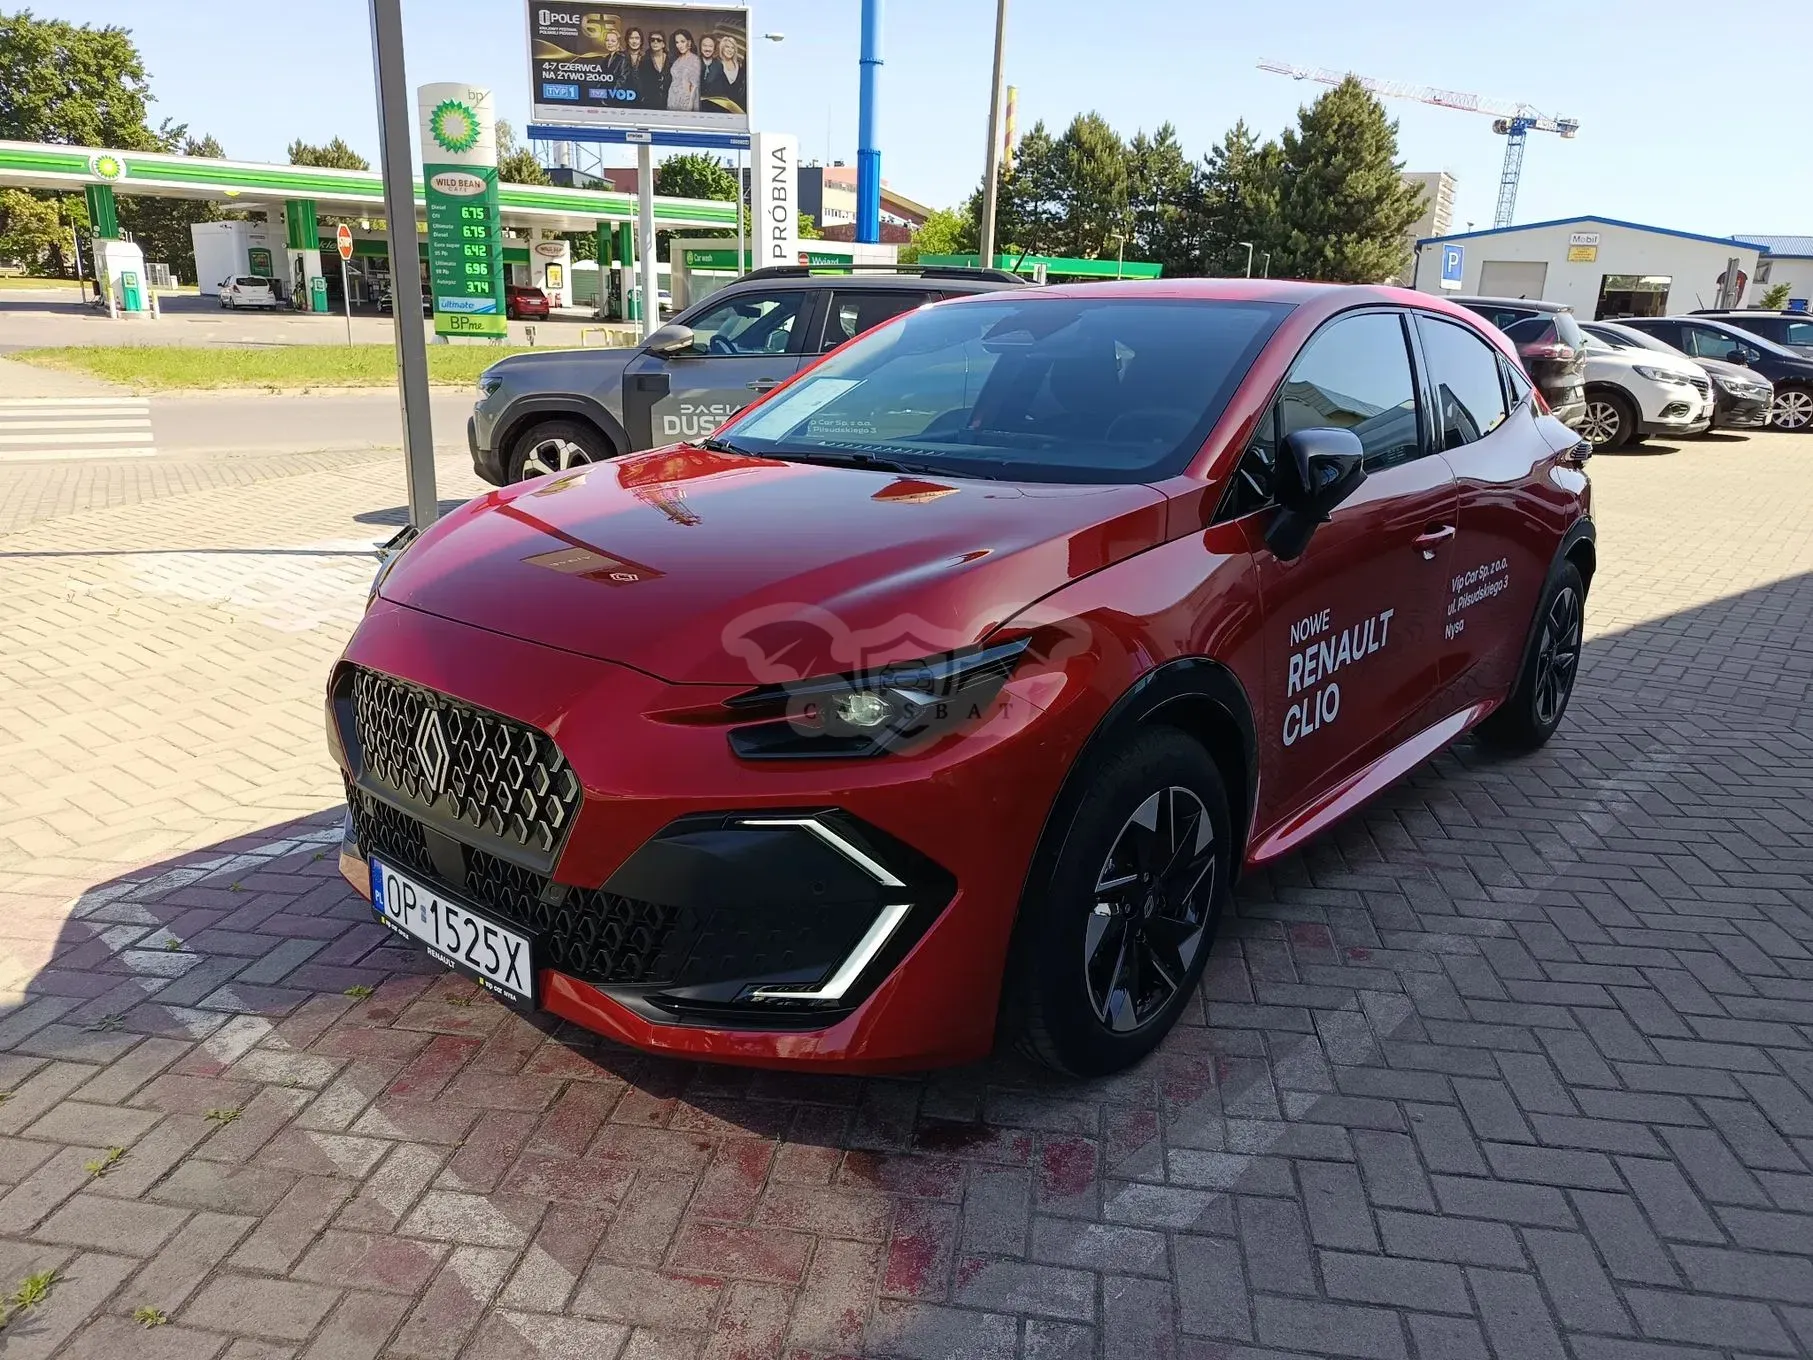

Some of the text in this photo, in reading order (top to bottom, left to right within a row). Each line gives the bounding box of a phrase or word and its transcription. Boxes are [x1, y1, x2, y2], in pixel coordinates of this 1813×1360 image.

[539, 10, 580, 25] OPOLE
[542, 62, 602, 72] 4-7 CZERWCA
[542, 71, 555, 79] NA
[557, 71, 585, 80] ŻYWO
[468, 89, 484, 103] bp
[608, 89, 636, 101] VOD
[436, 179, 481, 188] WILD BEAN
[769, 146, 787, 259] PRÓBNA
[461, 207, 484, 219] 6.75
[463, 226, 486, 238] 6.75
[1572, 235, 1598, 243] Mobil
[464, 245, 487, 257] 6.42
[465, 263, 488, 275] 6.96
[1448, 252, 1459, 273] P
[466, 281, 489, 293] 3.74
[663, 415, 730, 435] DUST
[1452, 574, 1464, 593] Vip
[1464, 571, 1479, 586] Car
[1478, 564, 1490, 581] Sp.
[1495, 557, 1508, 572] o.o.
[1447, 598, 1457, 616] ul.
[1503, 574, 1509, 589] 3
[1290, 608, 1331, 646] NOWE
[1445, 619, 1465, 640] Nysa
[1287, 608, 1394, 698] RENAULT
[1282, 683, 1340, 746] CLIO
[374, 890, 384, 905] PL
[387, 874, 523, 991] OP 1525X
[426, 946, 456, 969] RENAULT
